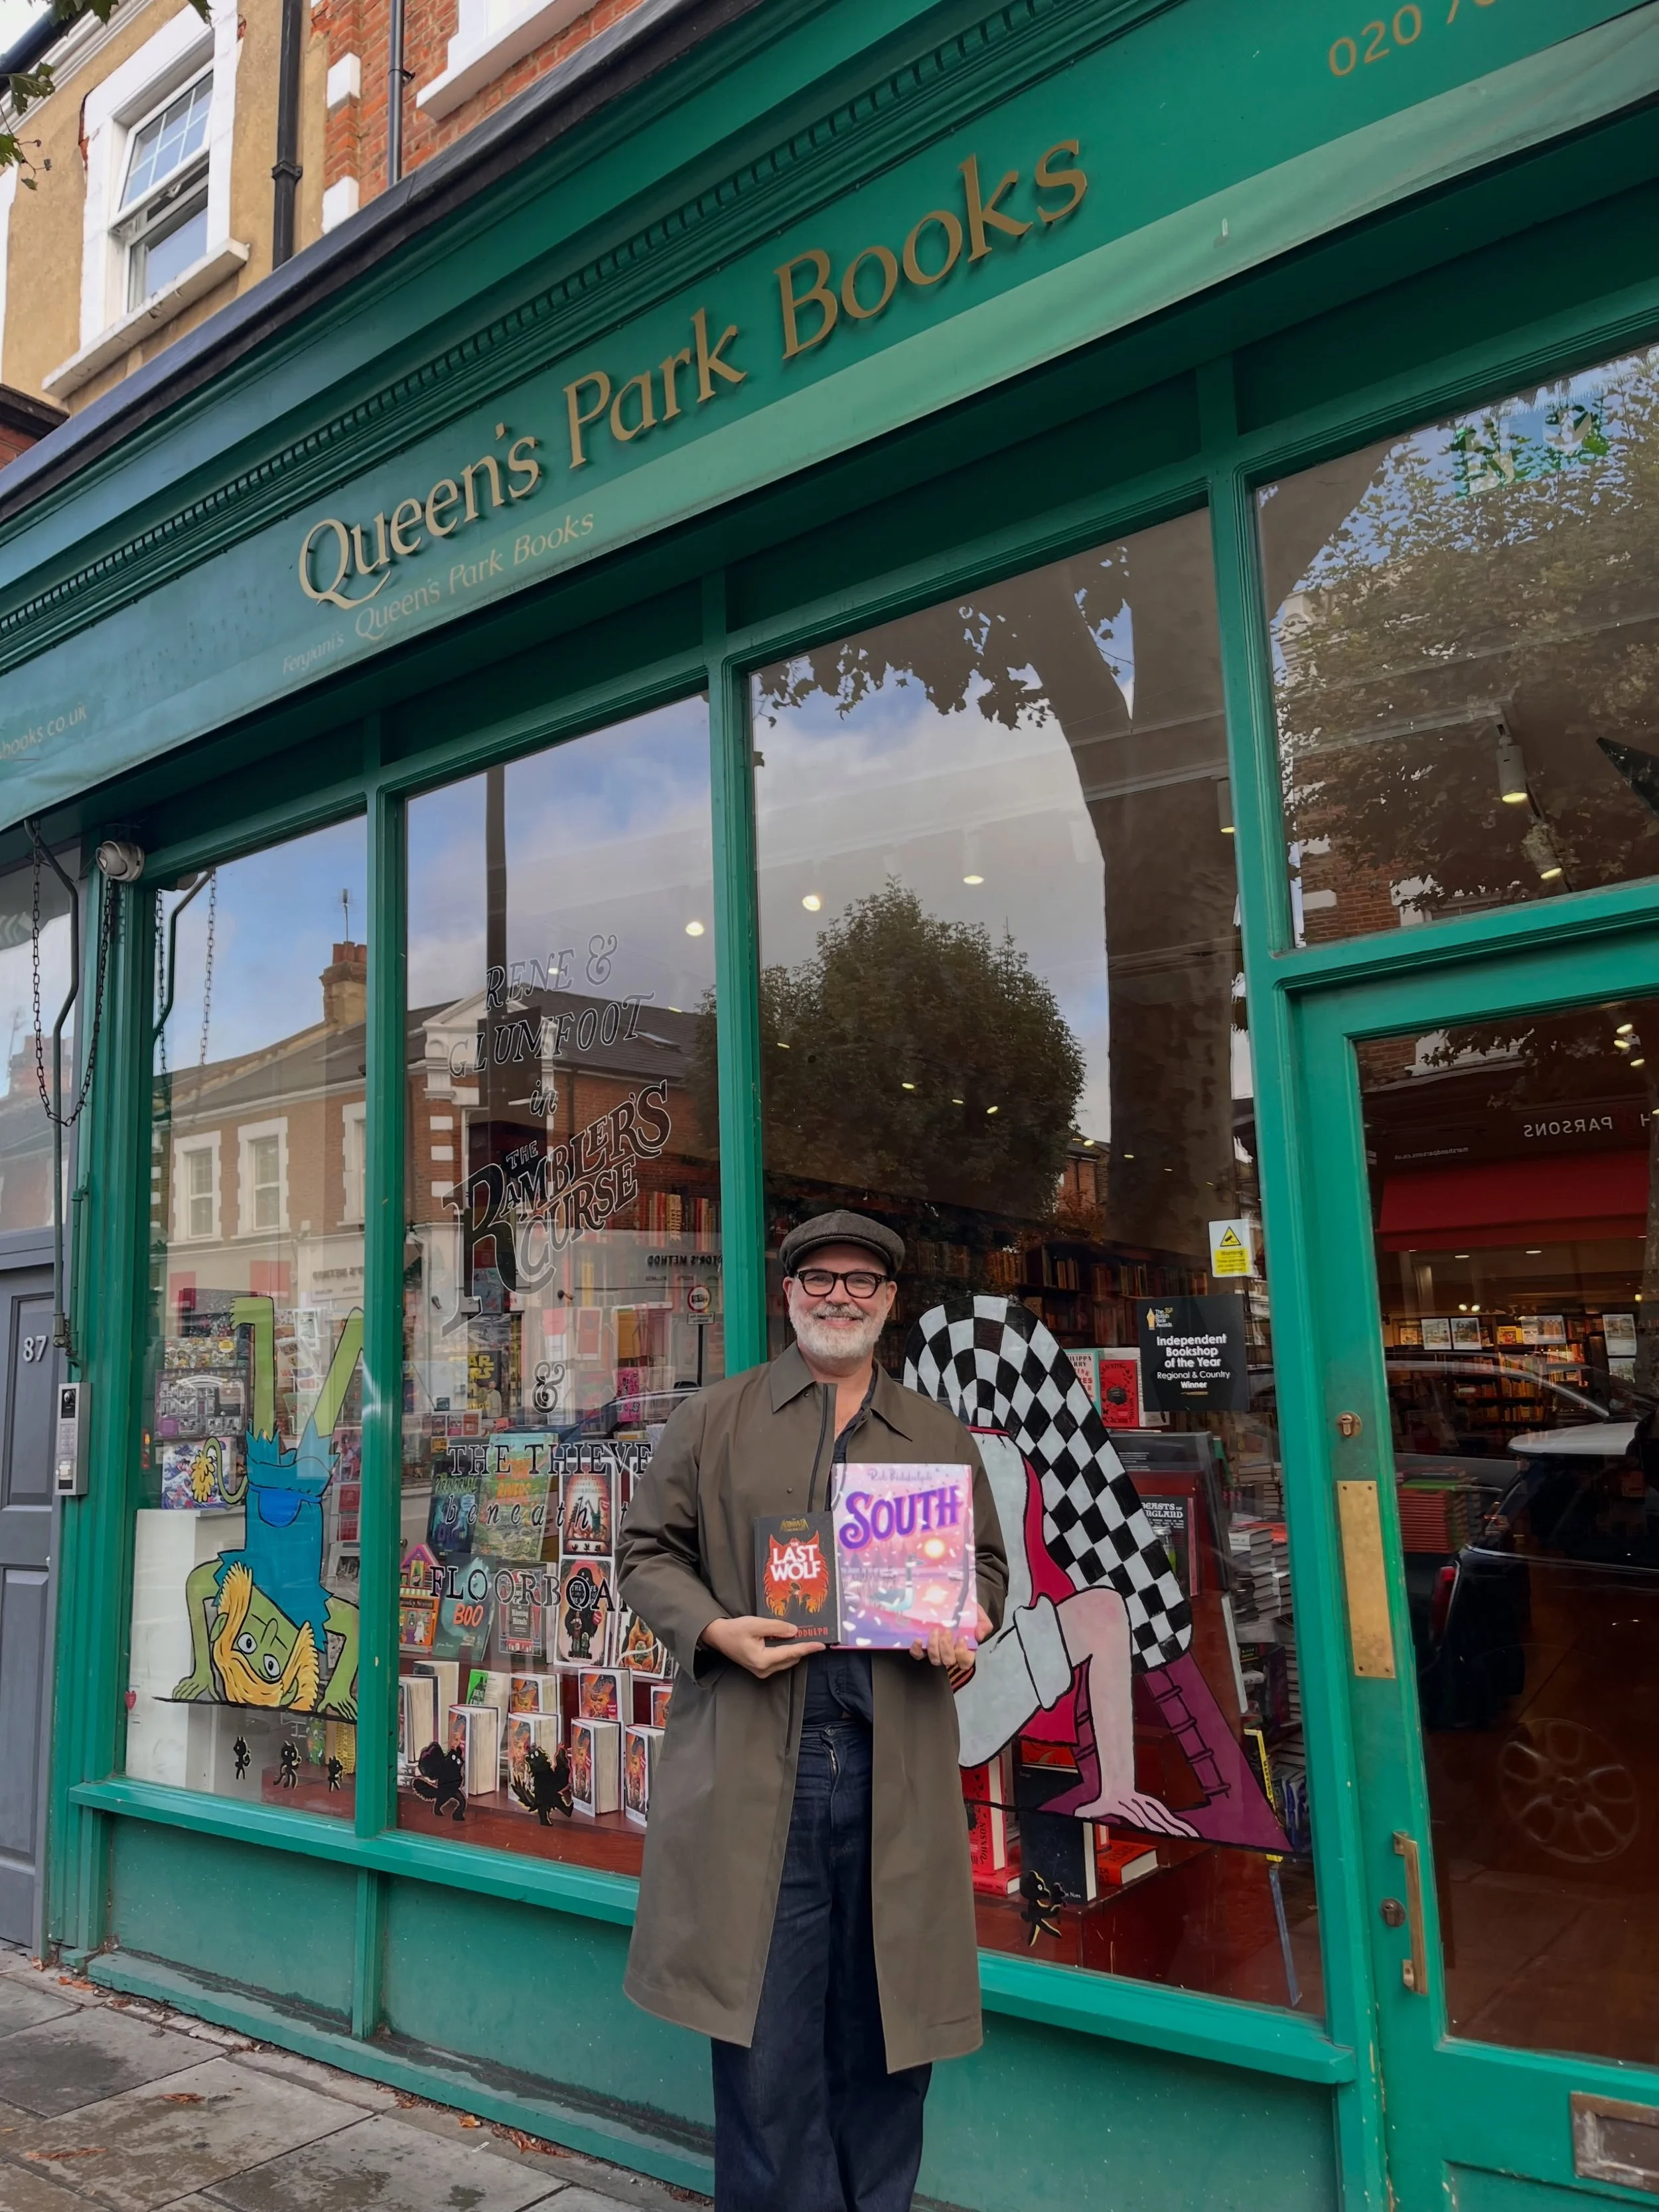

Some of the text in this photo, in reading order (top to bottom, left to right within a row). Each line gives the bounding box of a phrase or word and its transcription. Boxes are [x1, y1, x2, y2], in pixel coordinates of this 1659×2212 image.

[1329, 4, 1421, 77] 020
[298, 141, 1088, 610] Queen's Park Books
[355, 579, 441, 640] Queen's
[449, 549, 503, 595] Park
[514, 513, 594, 565] Books
[0, 702, 87, 759] books.co.uk
[485, 934, 618, 1011] RENE &
[449, 992, 655, 1077] GLUMFOOT
[530, 1080, 558, 1117] in
[506, 1140, 539, 1170] THE
[441, 1080, 672, 1337] RAMBLER'S
[519, 1154, 638, 1284] CURSE
[23, 1335, 48, 1363] 87
[1157, 1333, 1227, 1347] Independent
[1166, 1346, 1218, 1357] Bookshop
[1157, 1371, 1190, 1380] Regional
[1199, 1370, 1230, 1379] Country
[1165, 1357, 1221, 1368] of the Year
[532, 1361, 566, 1414] &
[446, 1443, 511, 1476] THE
[524, 1441, 653, 1477] THIEVE
[445, 1495, 591, 1530] beneath
[839, 1485, 964, 1550] SOUTH
[1144, 1510, 1183, 1518] NGLAND
[770, 1560, 821, 1582] WOLF
[773, 1544, 818, 1564] LAST
[429, 1565, 628, 1612] FLOORBOA
[453, 1603, 484, 1627] BOO
[795, 1627, 828, 1639] DDULPH
